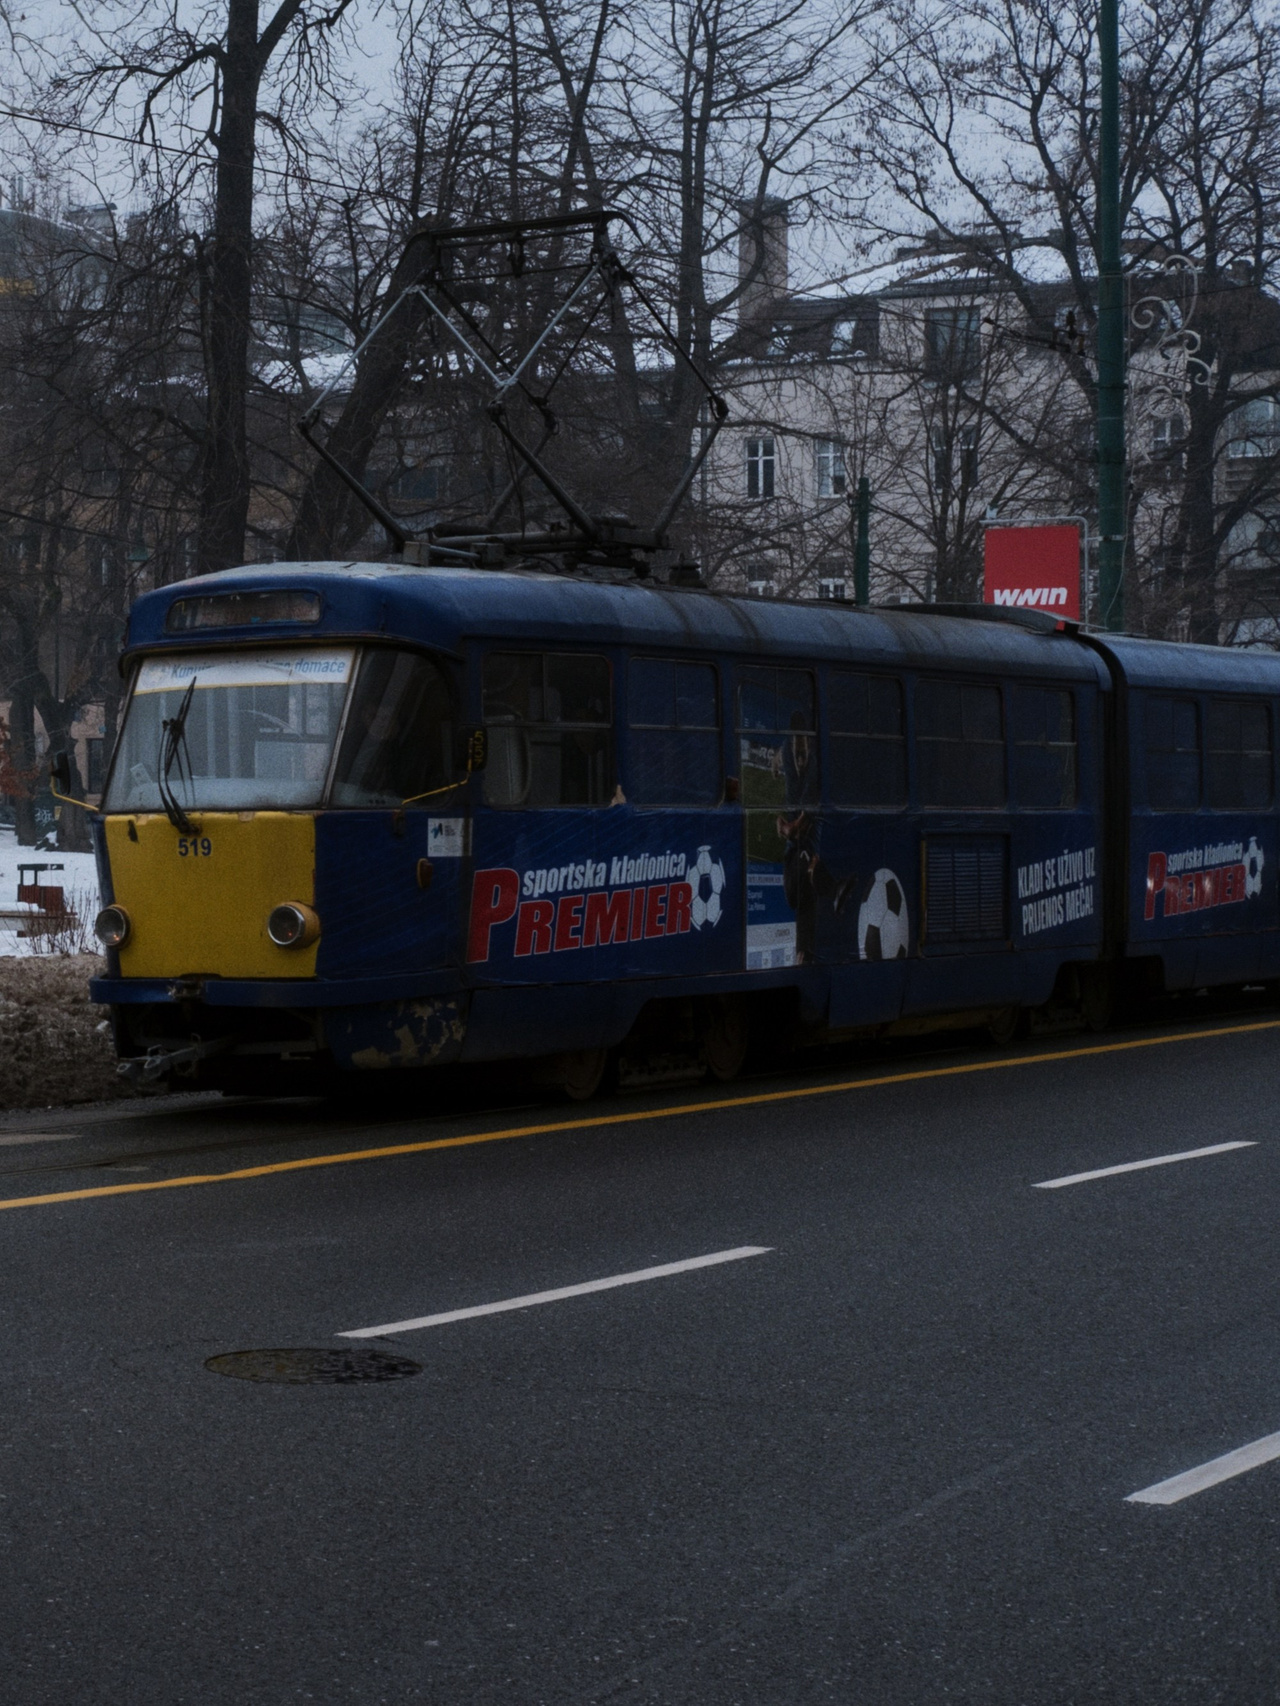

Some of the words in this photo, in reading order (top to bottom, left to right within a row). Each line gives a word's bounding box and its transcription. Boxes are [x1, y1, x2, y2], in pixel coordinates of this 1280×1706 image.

[178, 838, 212, 856] 519
[522, 858, 607, 898] sportska
[609, 849, 687, 885] kladionica
[1017, 862, 1043, 899] KLADI
[1044, 858, 1056, 891] SE
[1057, 848, 1083, 887] UŽIVO
[1084, 846, 1096, 879] UZ
[1168, 847, 1203, 874] sportska
[1204, 840, 1243, 865] kladionica
[1022, 893, 1064, 936] PRIJENOS
[1065, 882, 1094, 922] MEČA!
[1144, 851, 1246, 921] PREMIER
[466, 867, 693, 963] PREMIER
